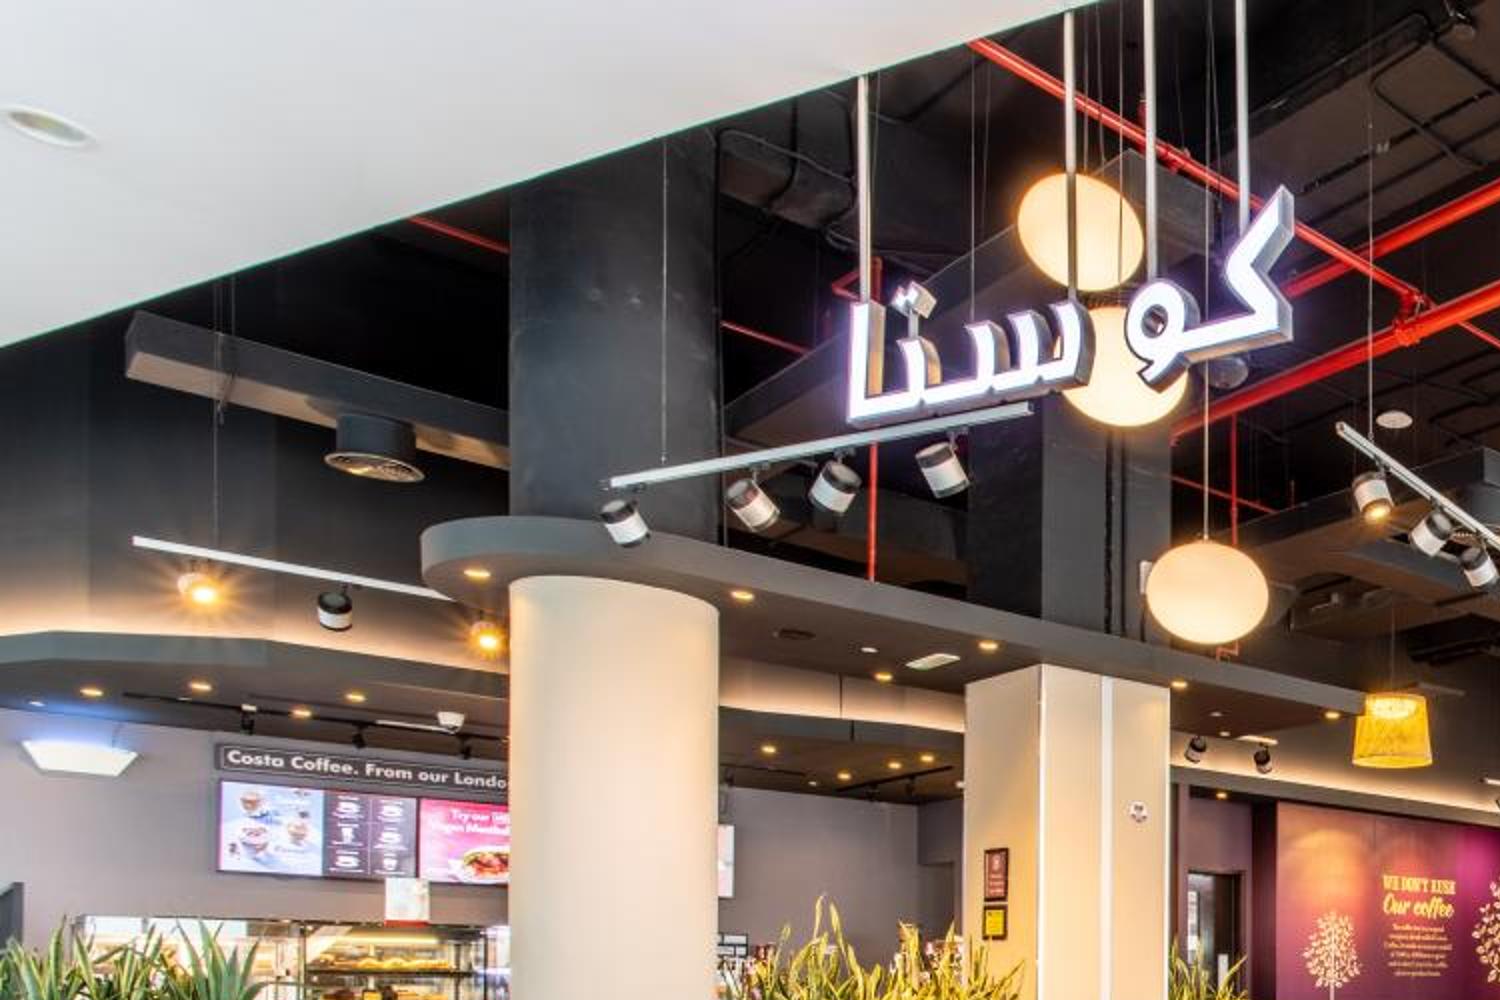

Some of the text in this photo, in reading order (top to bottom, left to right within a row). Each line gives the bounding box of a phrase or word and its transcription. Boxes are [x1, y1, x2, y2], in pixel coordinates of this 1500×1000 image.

[226, 749, 285, 769] Costa
[290, 755, 359, 777] Coffee.
[365, 763, 413, 781] From
[418, 771, 449, 784] our
[1383, 893, 1455, 920] Our coffee
